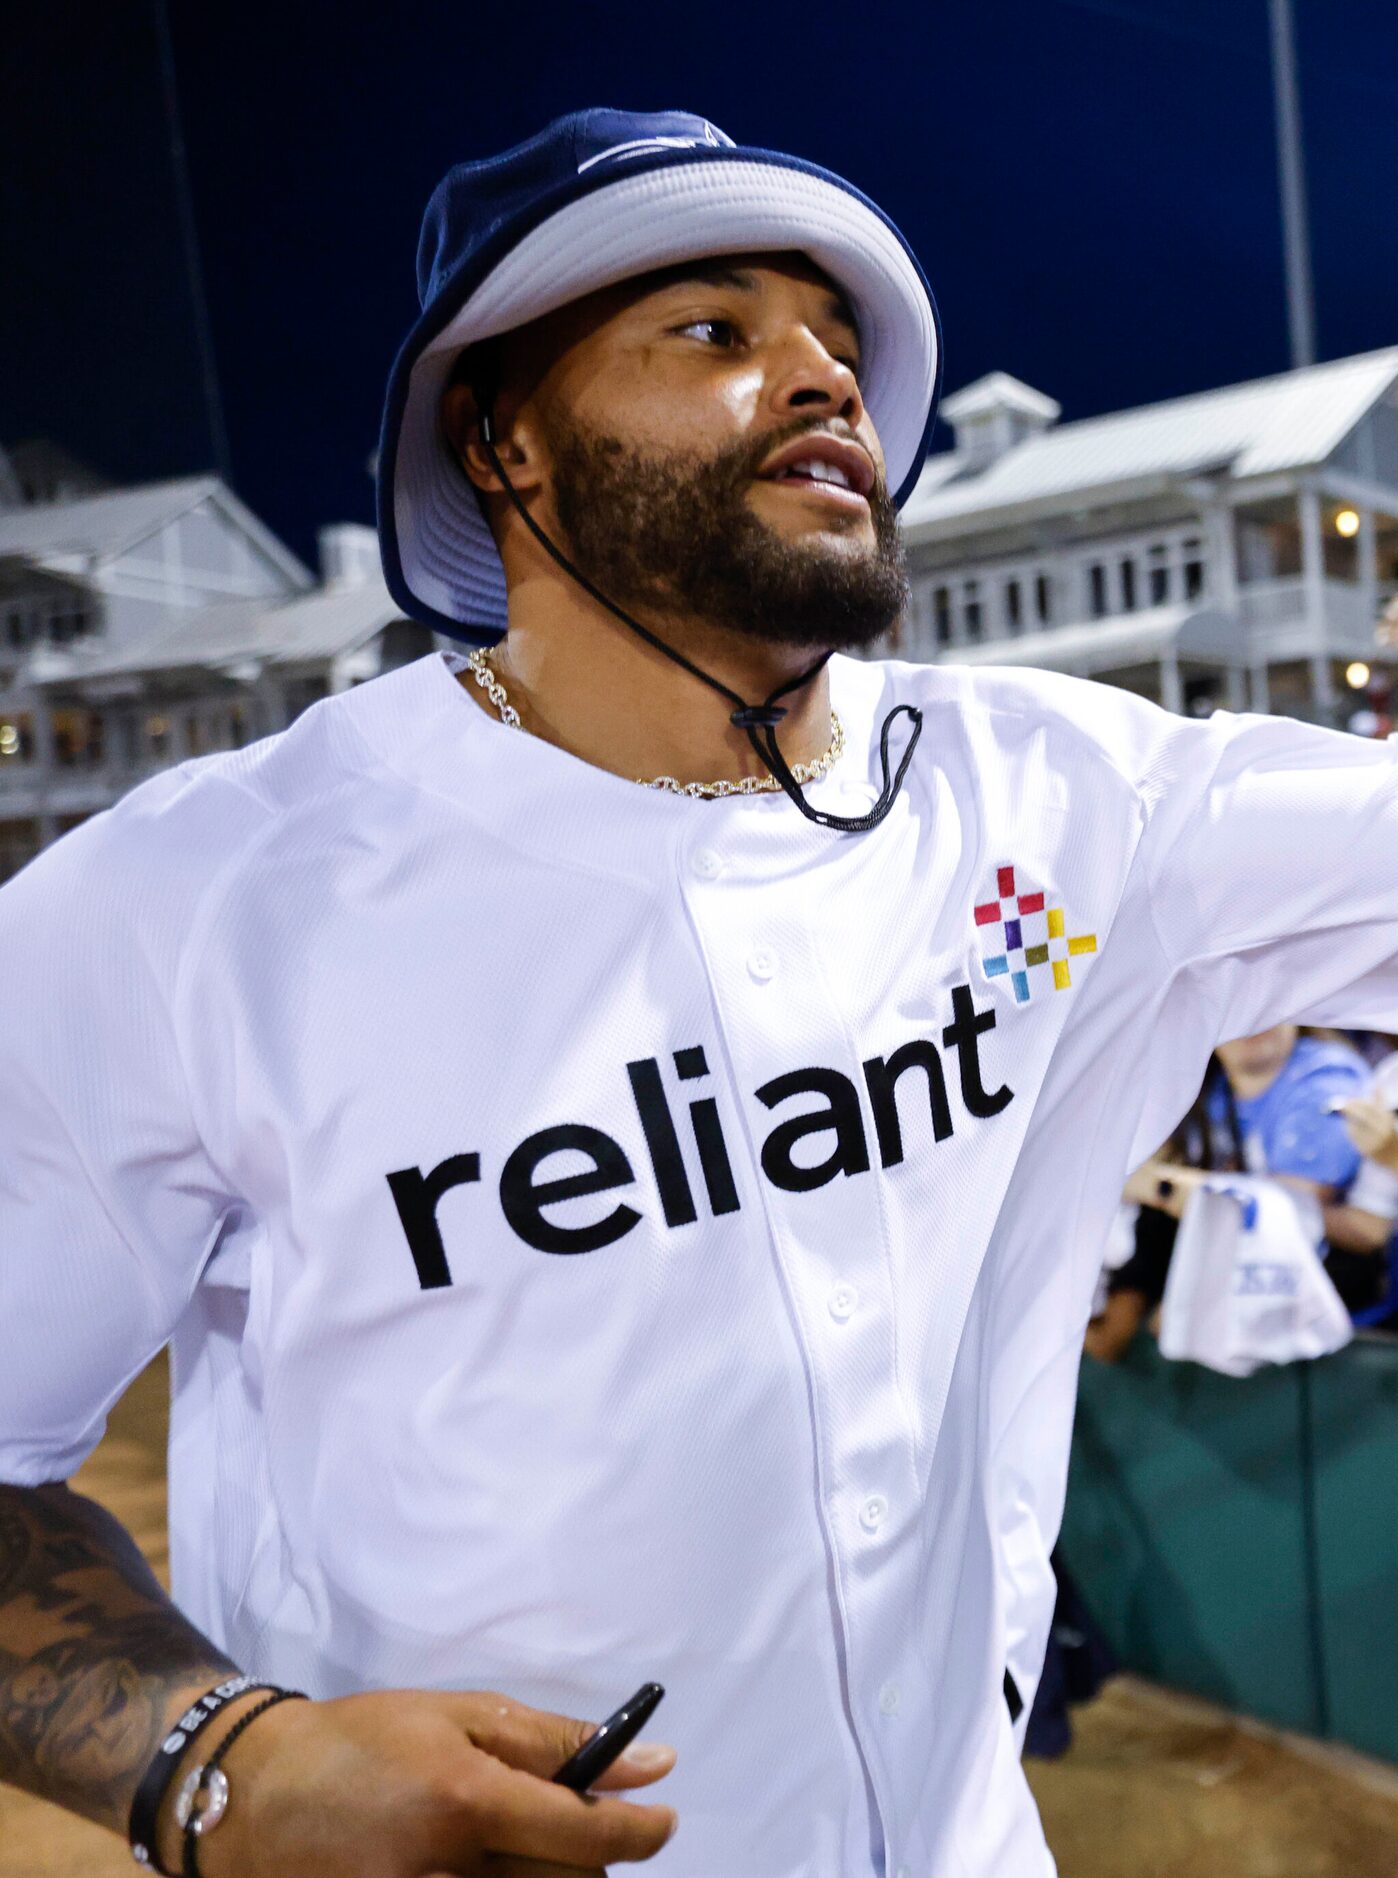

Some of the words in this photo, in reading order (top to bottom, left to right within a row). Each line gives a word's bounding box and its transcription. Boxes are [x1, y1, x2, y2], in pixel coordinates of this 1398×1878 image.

[386, 984, 1014, 1290] reliant
[179, 1707, 208, 1732] BE
[202, 1695, 222, 1711] A
